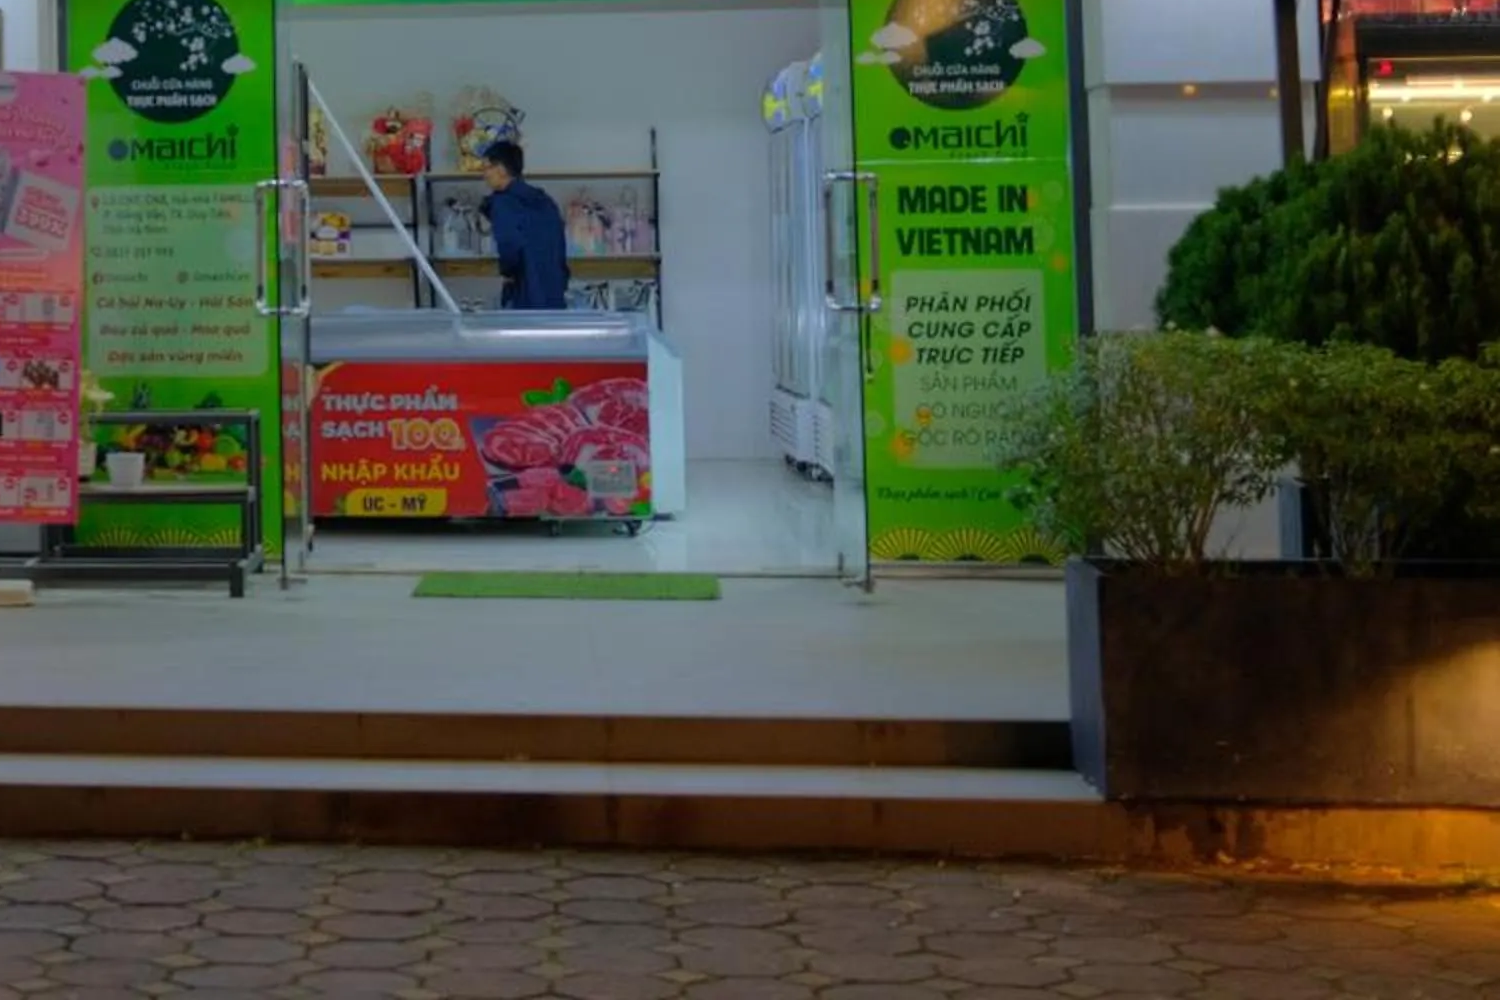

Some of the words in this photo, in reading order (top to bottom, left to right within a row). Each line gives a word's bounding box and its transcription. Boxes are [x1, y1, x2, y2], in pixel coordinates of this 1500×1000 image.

[913, 113, 1031, 151] Maichi
[897, 186, 988, 214] MADE
[997, 185, 1029, 214] IN
[895, 227, 1034, 257] VIETNAM
[905, 294, 969, 313] PHÂN
[975, 288, 1032, 313] PHỐI
[907, 321, 976, 339] CUNG
[982, 314, 1032, 338] CẤP
[915, 345, 974, 370] TRỰC
[981, 340, 1025, 365] TIẾP
[322, 391, 386, 415] THỰC
[388, 385, 458, 412] PHẨM
[320, 419, 384, 441] SẠCH
[320, 459, 388, 486] NHẬP
[394, 454, 461, 482] KHẨU
